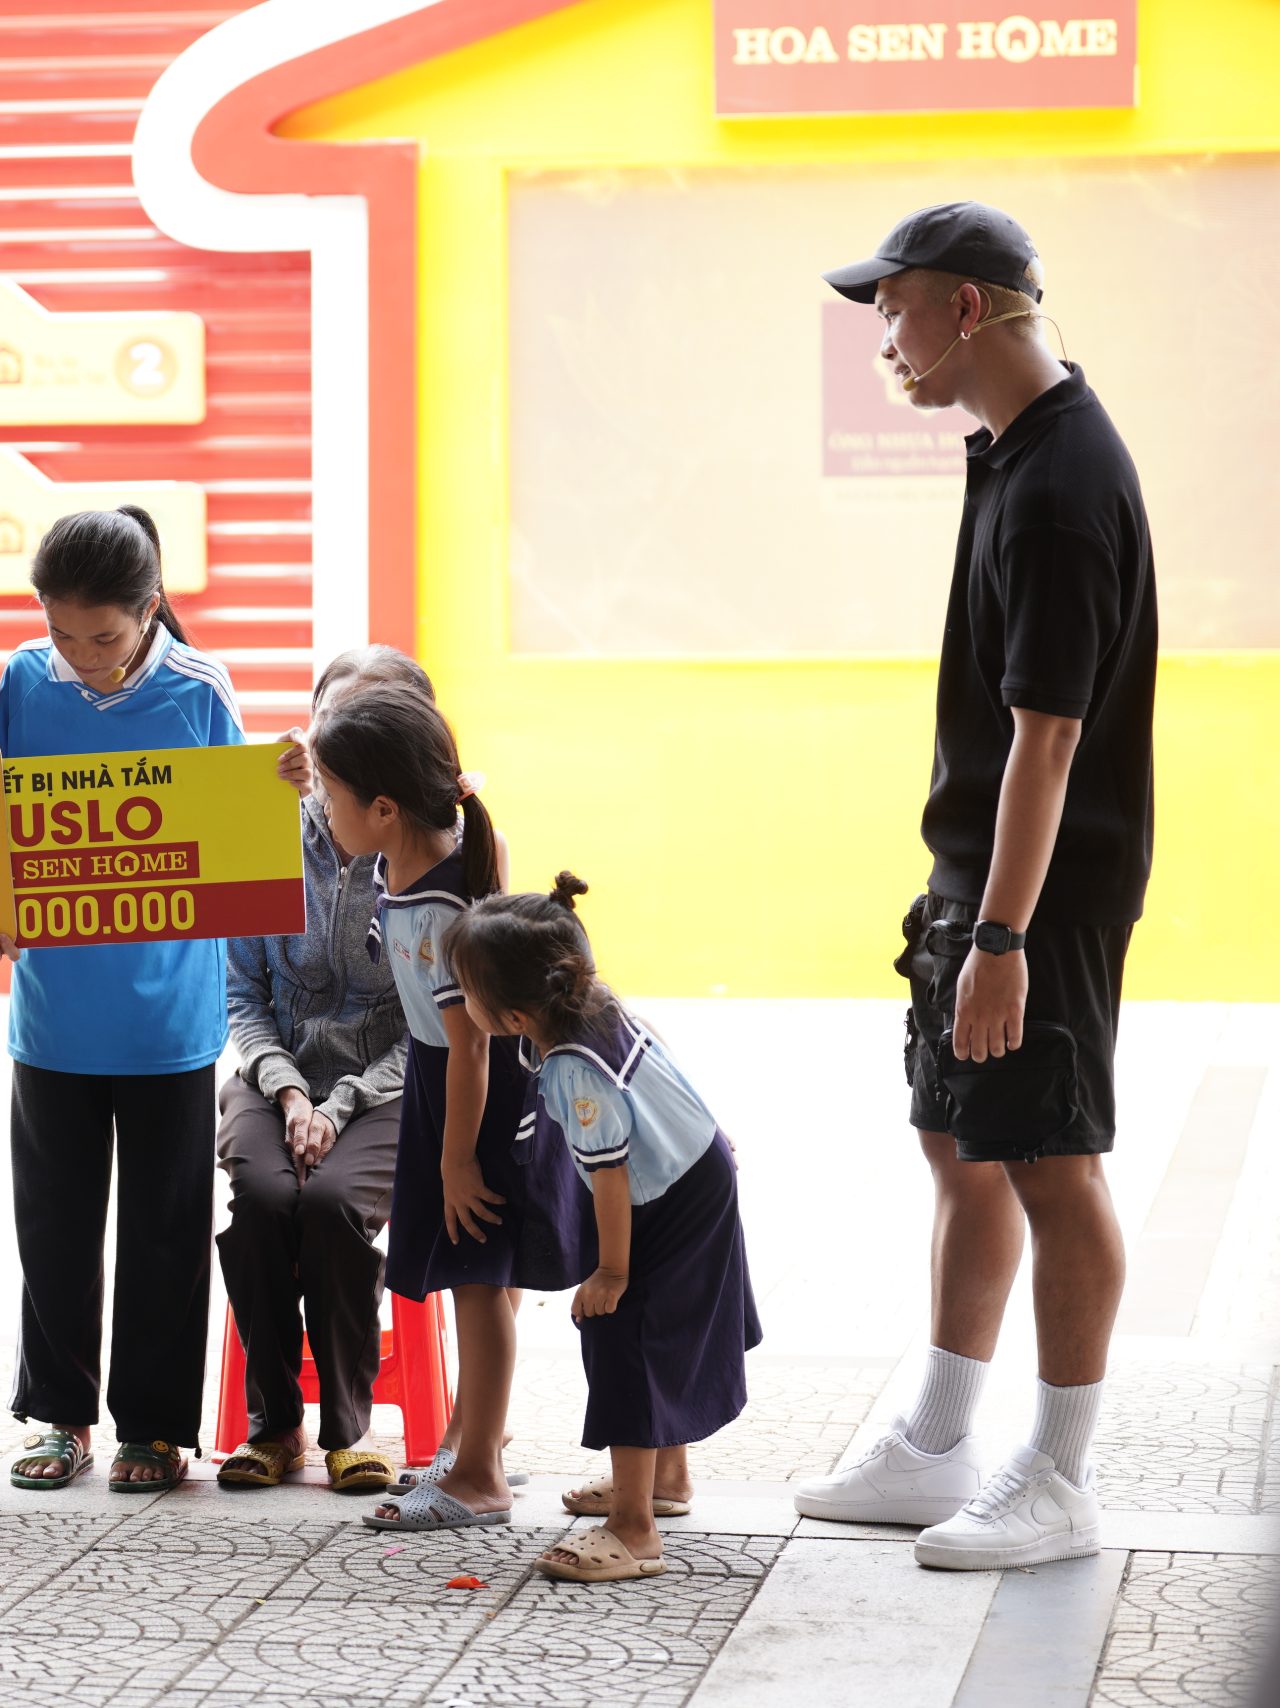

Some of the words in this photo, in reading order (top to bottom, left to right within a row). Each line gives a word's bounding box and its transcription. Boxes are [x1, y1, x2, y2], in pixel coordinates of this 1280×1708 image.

[732, 26, 840, 65] HOA
[847, 23, 948, 63] SEN
[956, 15, 1118, 63] HOME
[129, 341, 166, 386] 2
[32, 772, 53, 797] BỊ
[62, 763, 114, 790] NHÀ
[121, 756, 172, 787] TẮM
[10, 796, 163, 847] USLO
[23, 857, 82, 880] SEN
[91, 851, 187, 877] HOME
[18, 890, 195, 939] 000.000
